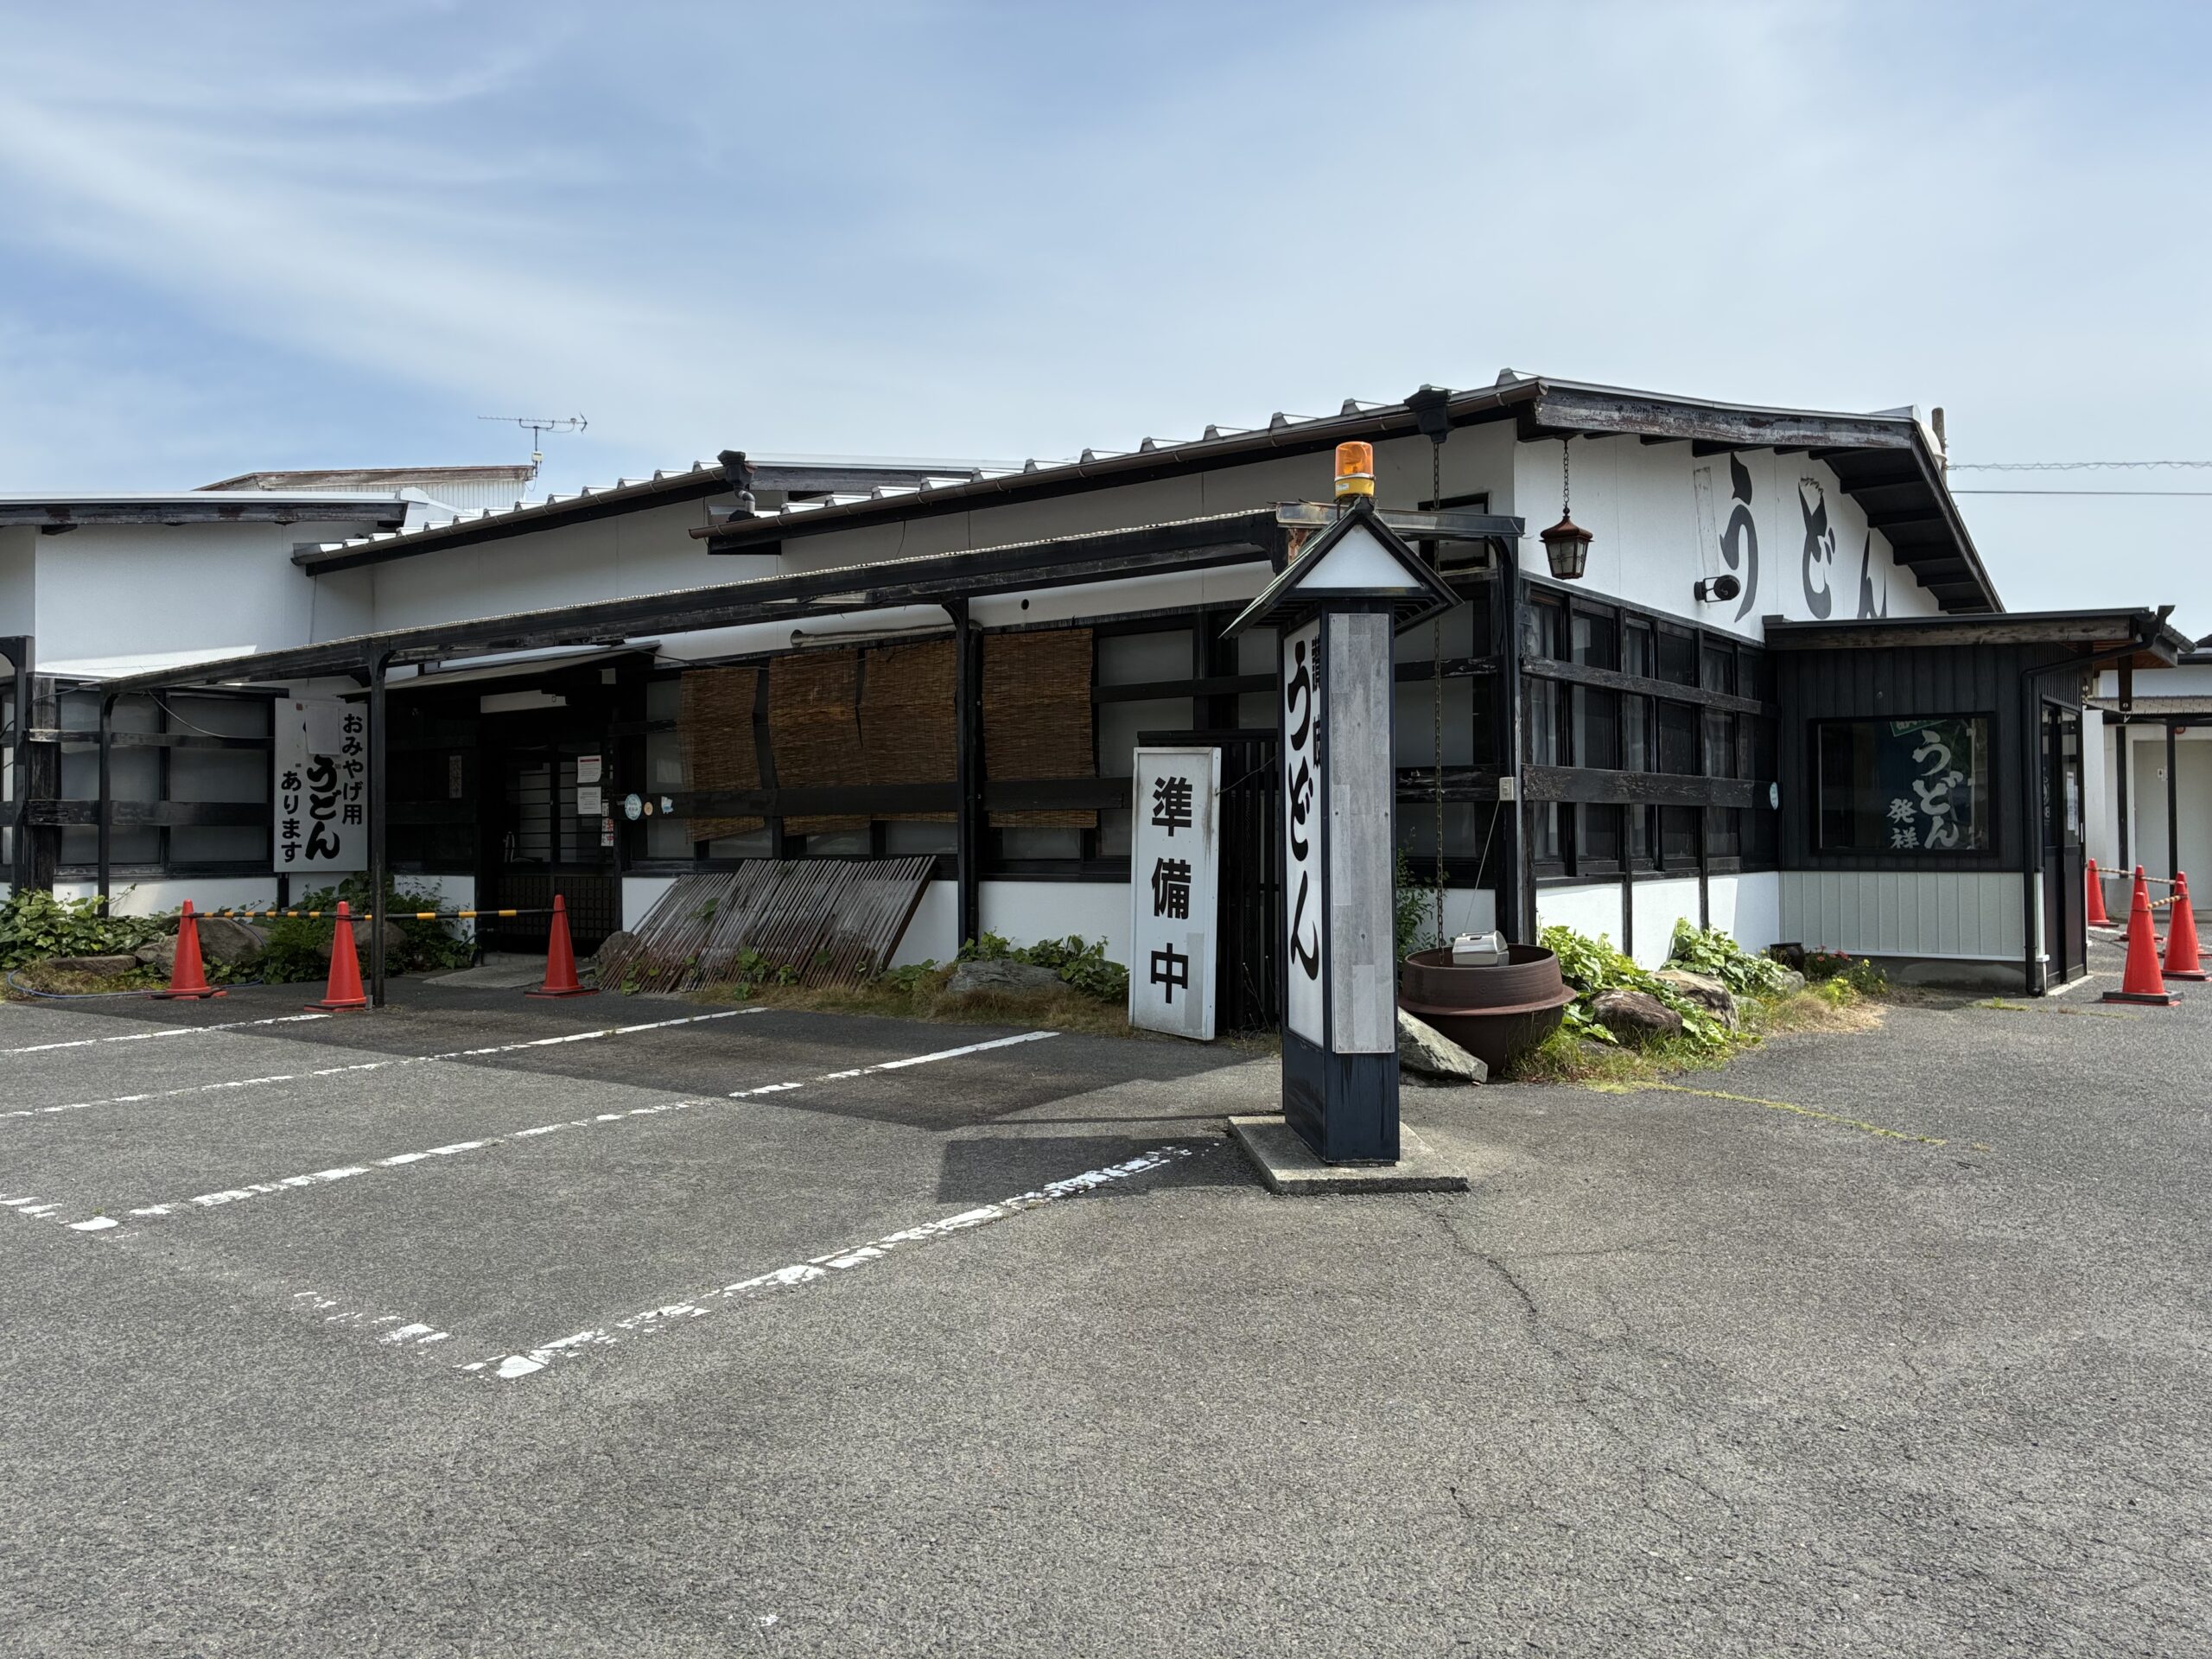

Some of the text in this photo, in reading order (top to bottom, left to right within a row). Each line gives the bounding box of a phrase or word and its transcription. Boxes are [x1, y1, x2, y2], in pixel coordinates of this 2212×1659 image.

[281, 770, 302, 862] あります
[304, 721, 340, 861] うどん
[341, 713, 364, 825] おみやげ用
[1287, 639, 1319, 981] うどん
[1887, 798, 1920, 849] 発祥
[1911, 728, 1964, 849] うどん
[1150, 776, 1193, 1004] 準備中
